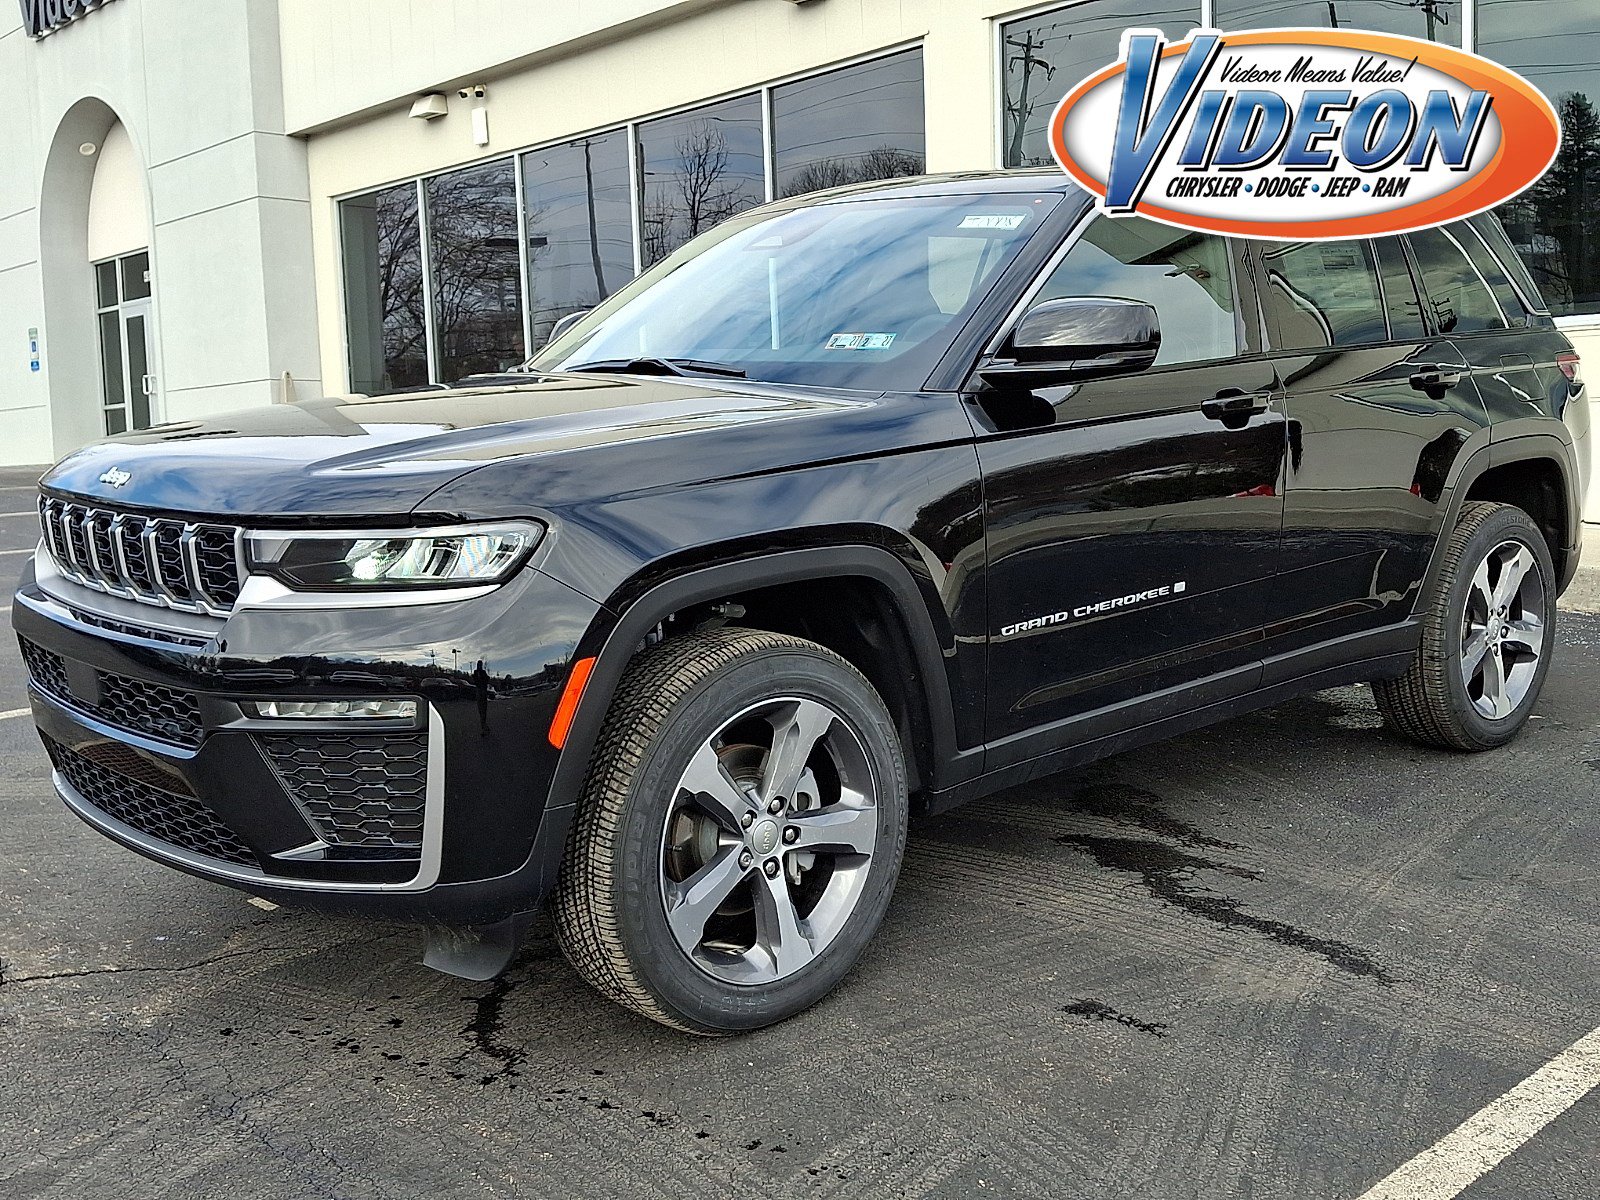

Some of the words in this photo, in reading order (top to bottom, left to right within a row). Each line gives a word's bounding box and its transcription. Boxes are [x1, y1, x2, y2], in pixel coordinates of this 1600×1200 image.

[19, 0, 93, 37] Vide
[1001, 611, 1068, 636] GRAND
[1073, 585, 1171, 617] CHEROKEE
